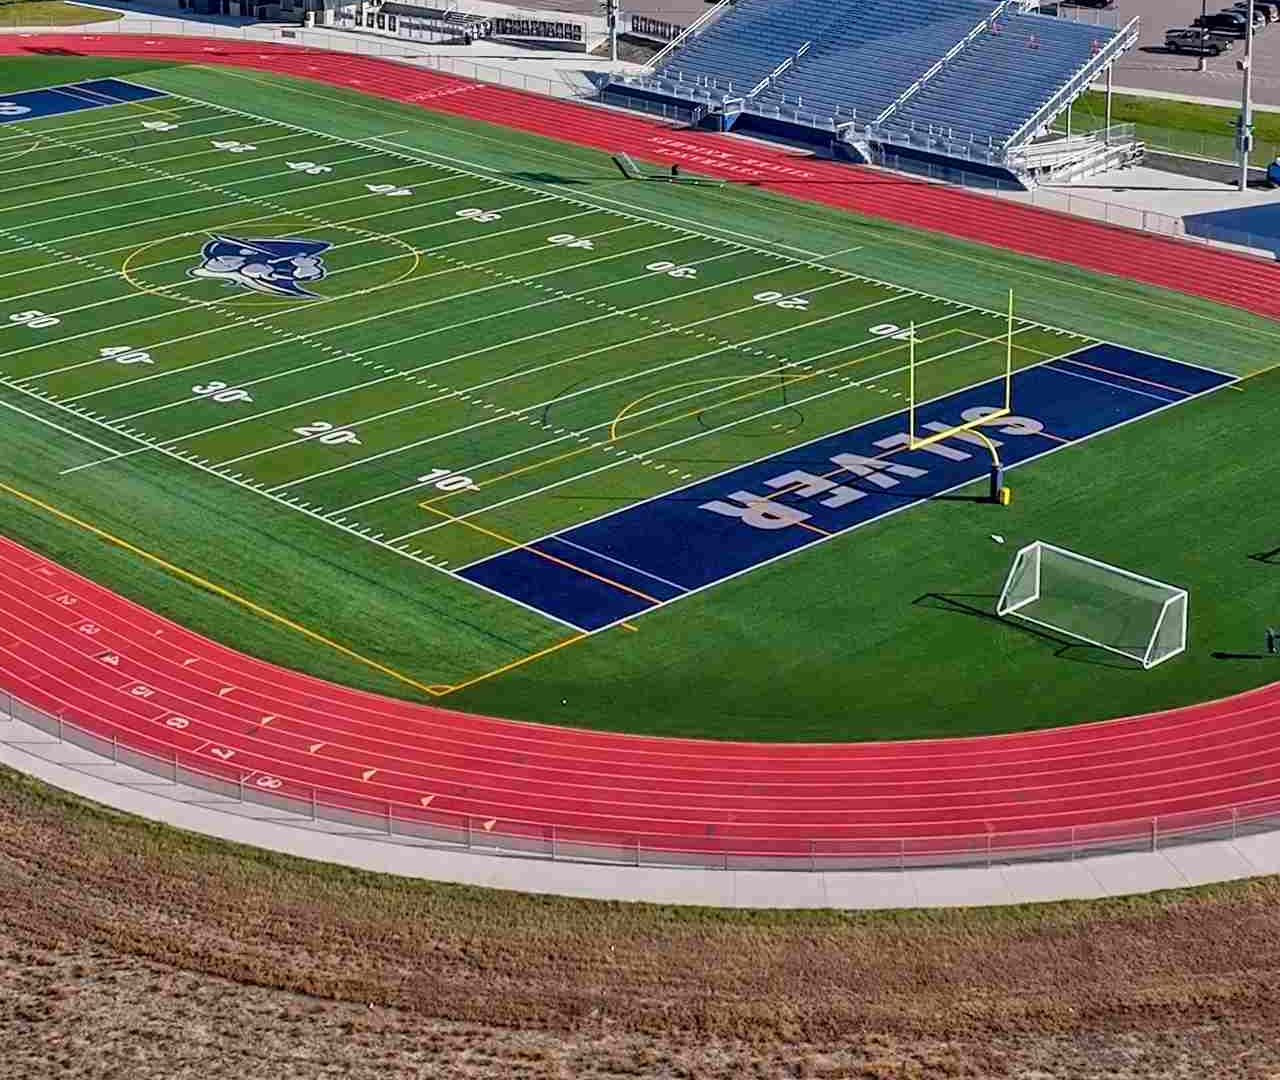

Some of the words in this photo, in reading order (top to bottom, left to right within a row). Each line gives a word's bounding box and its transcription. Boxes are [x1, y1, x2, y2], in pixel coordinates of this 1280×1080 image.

[455, 208, 502, 223] 50
[547, 234, 593, 250] 40
[646, 261, 696, 279] 30
[752, 291, 809, 311] 20
[9, 310, 61, 328] 50
[100, 346, 152, 364] 40
[192, 381, 248, 402] 30
[293, 422, 356, 444] 20
[697, 406, 1045, 530] SILVER
[417, 468, 474, 491] 10
[256, 776, 283, 789] 8
